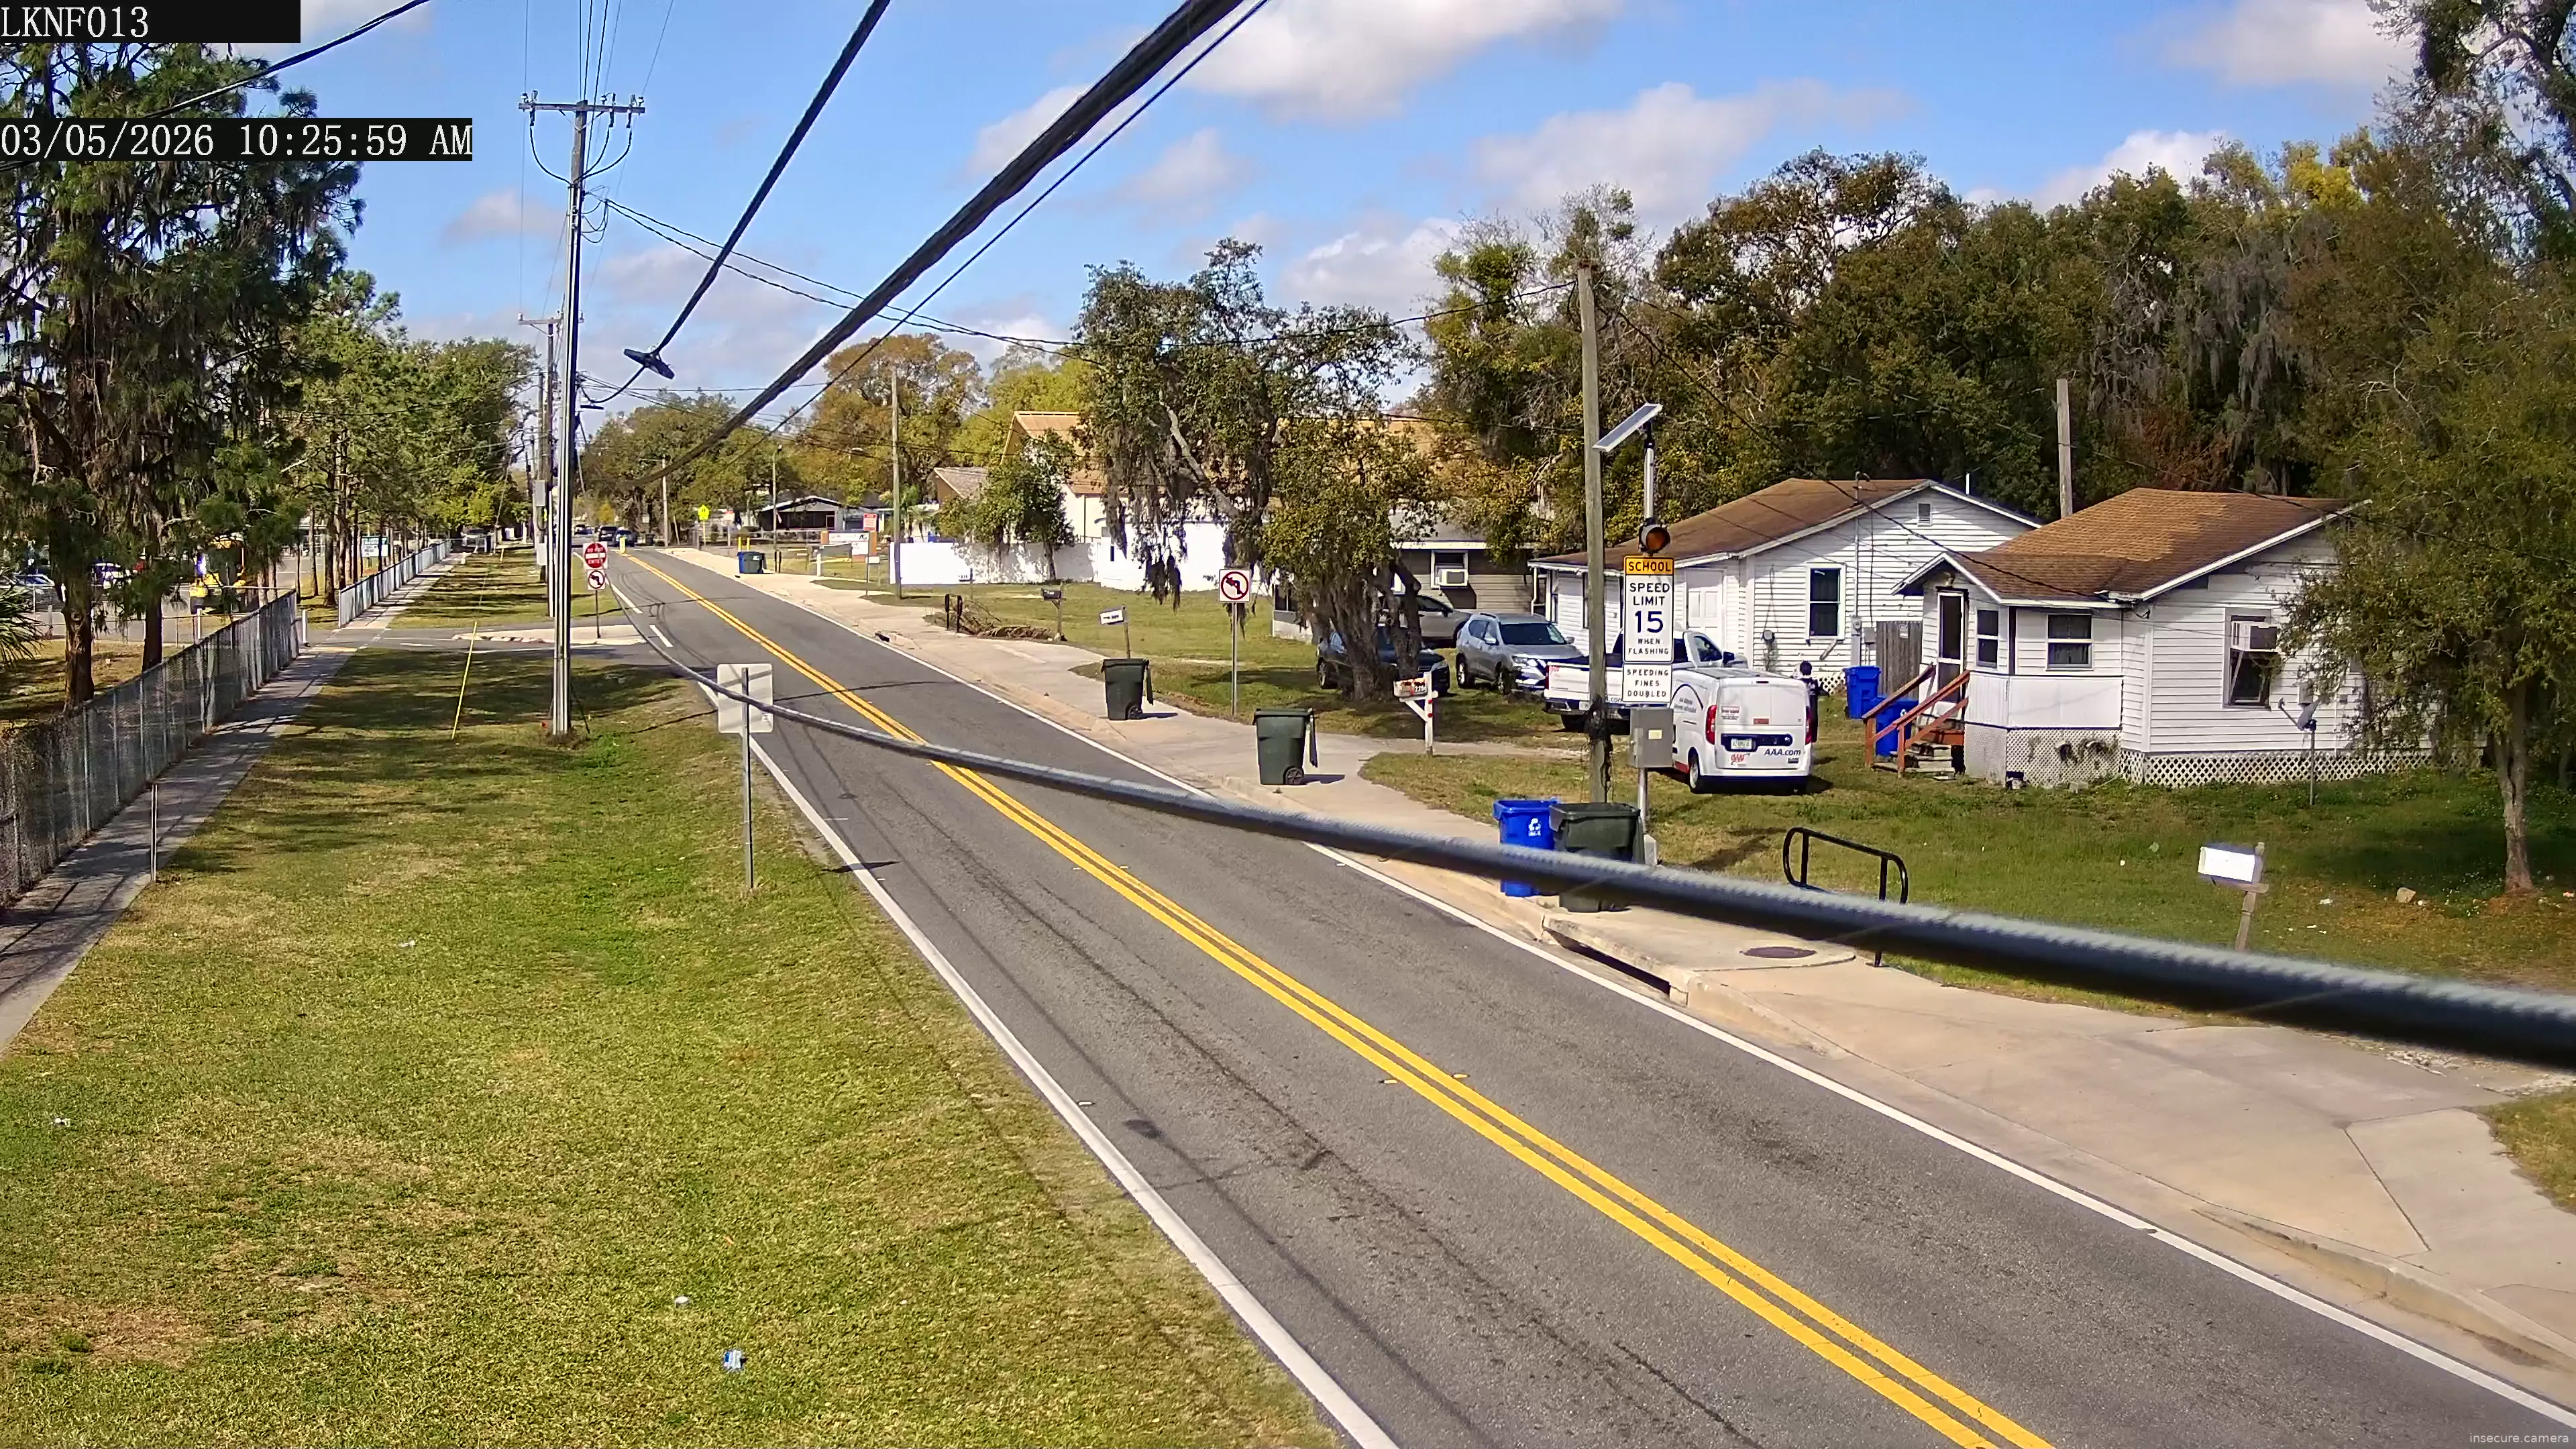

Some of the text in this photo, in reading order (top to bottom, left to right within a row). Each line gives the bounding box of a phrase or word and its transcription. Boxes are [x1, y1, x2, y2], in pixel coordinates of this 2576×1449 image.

[1628, 561, 1672, 572] SCHOOL
[1629, 582, 1670, 593] SPEED
[1633, 596, 1665, 606] LIMIT
[1634, 610, 1664, 633] 15
[1764, 748, 1801, 756] AAA.com
